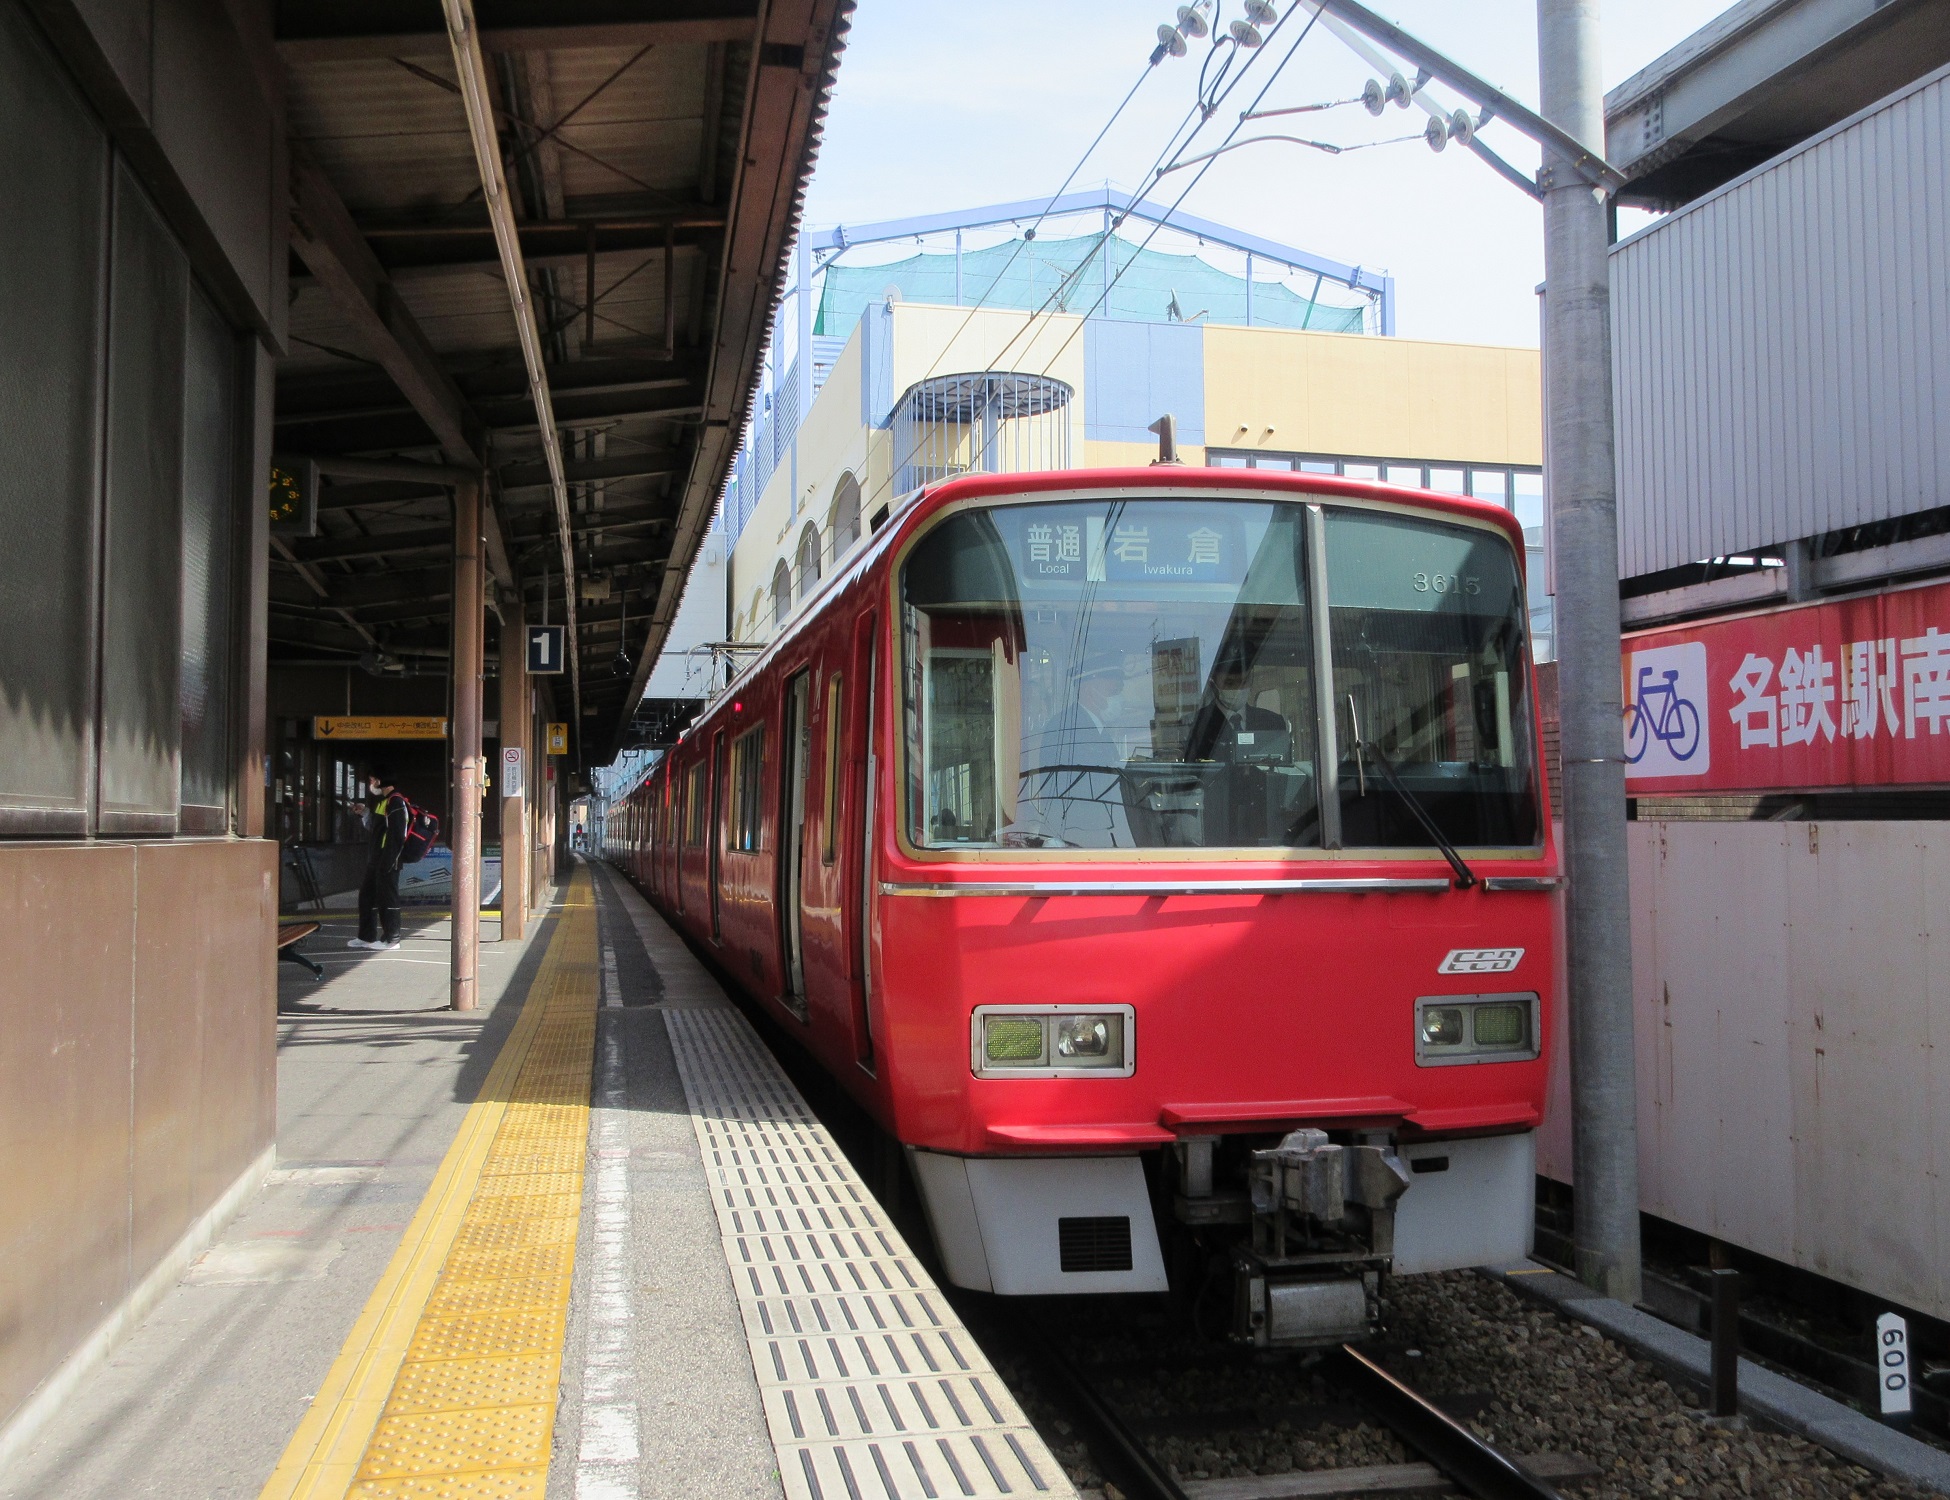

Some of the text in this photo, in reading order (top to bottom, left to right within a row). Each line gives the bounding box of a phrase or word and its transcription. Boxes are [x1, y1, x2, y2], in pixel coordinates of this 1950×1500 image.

[1027, 523, 1081, 562] 普通
[1113, 525, 1223, 565] 岩倉
[1039, 563, 1070, 574] Local
[1143, 563, 1194, 576] Iwakura
[1412, 572, 1481, 596] 3615
[532, 632, 550, 665] 1
[1728, 627, 1950, 750] 名鉄駅南
[1881, 1329, 1906, 1391] 600
